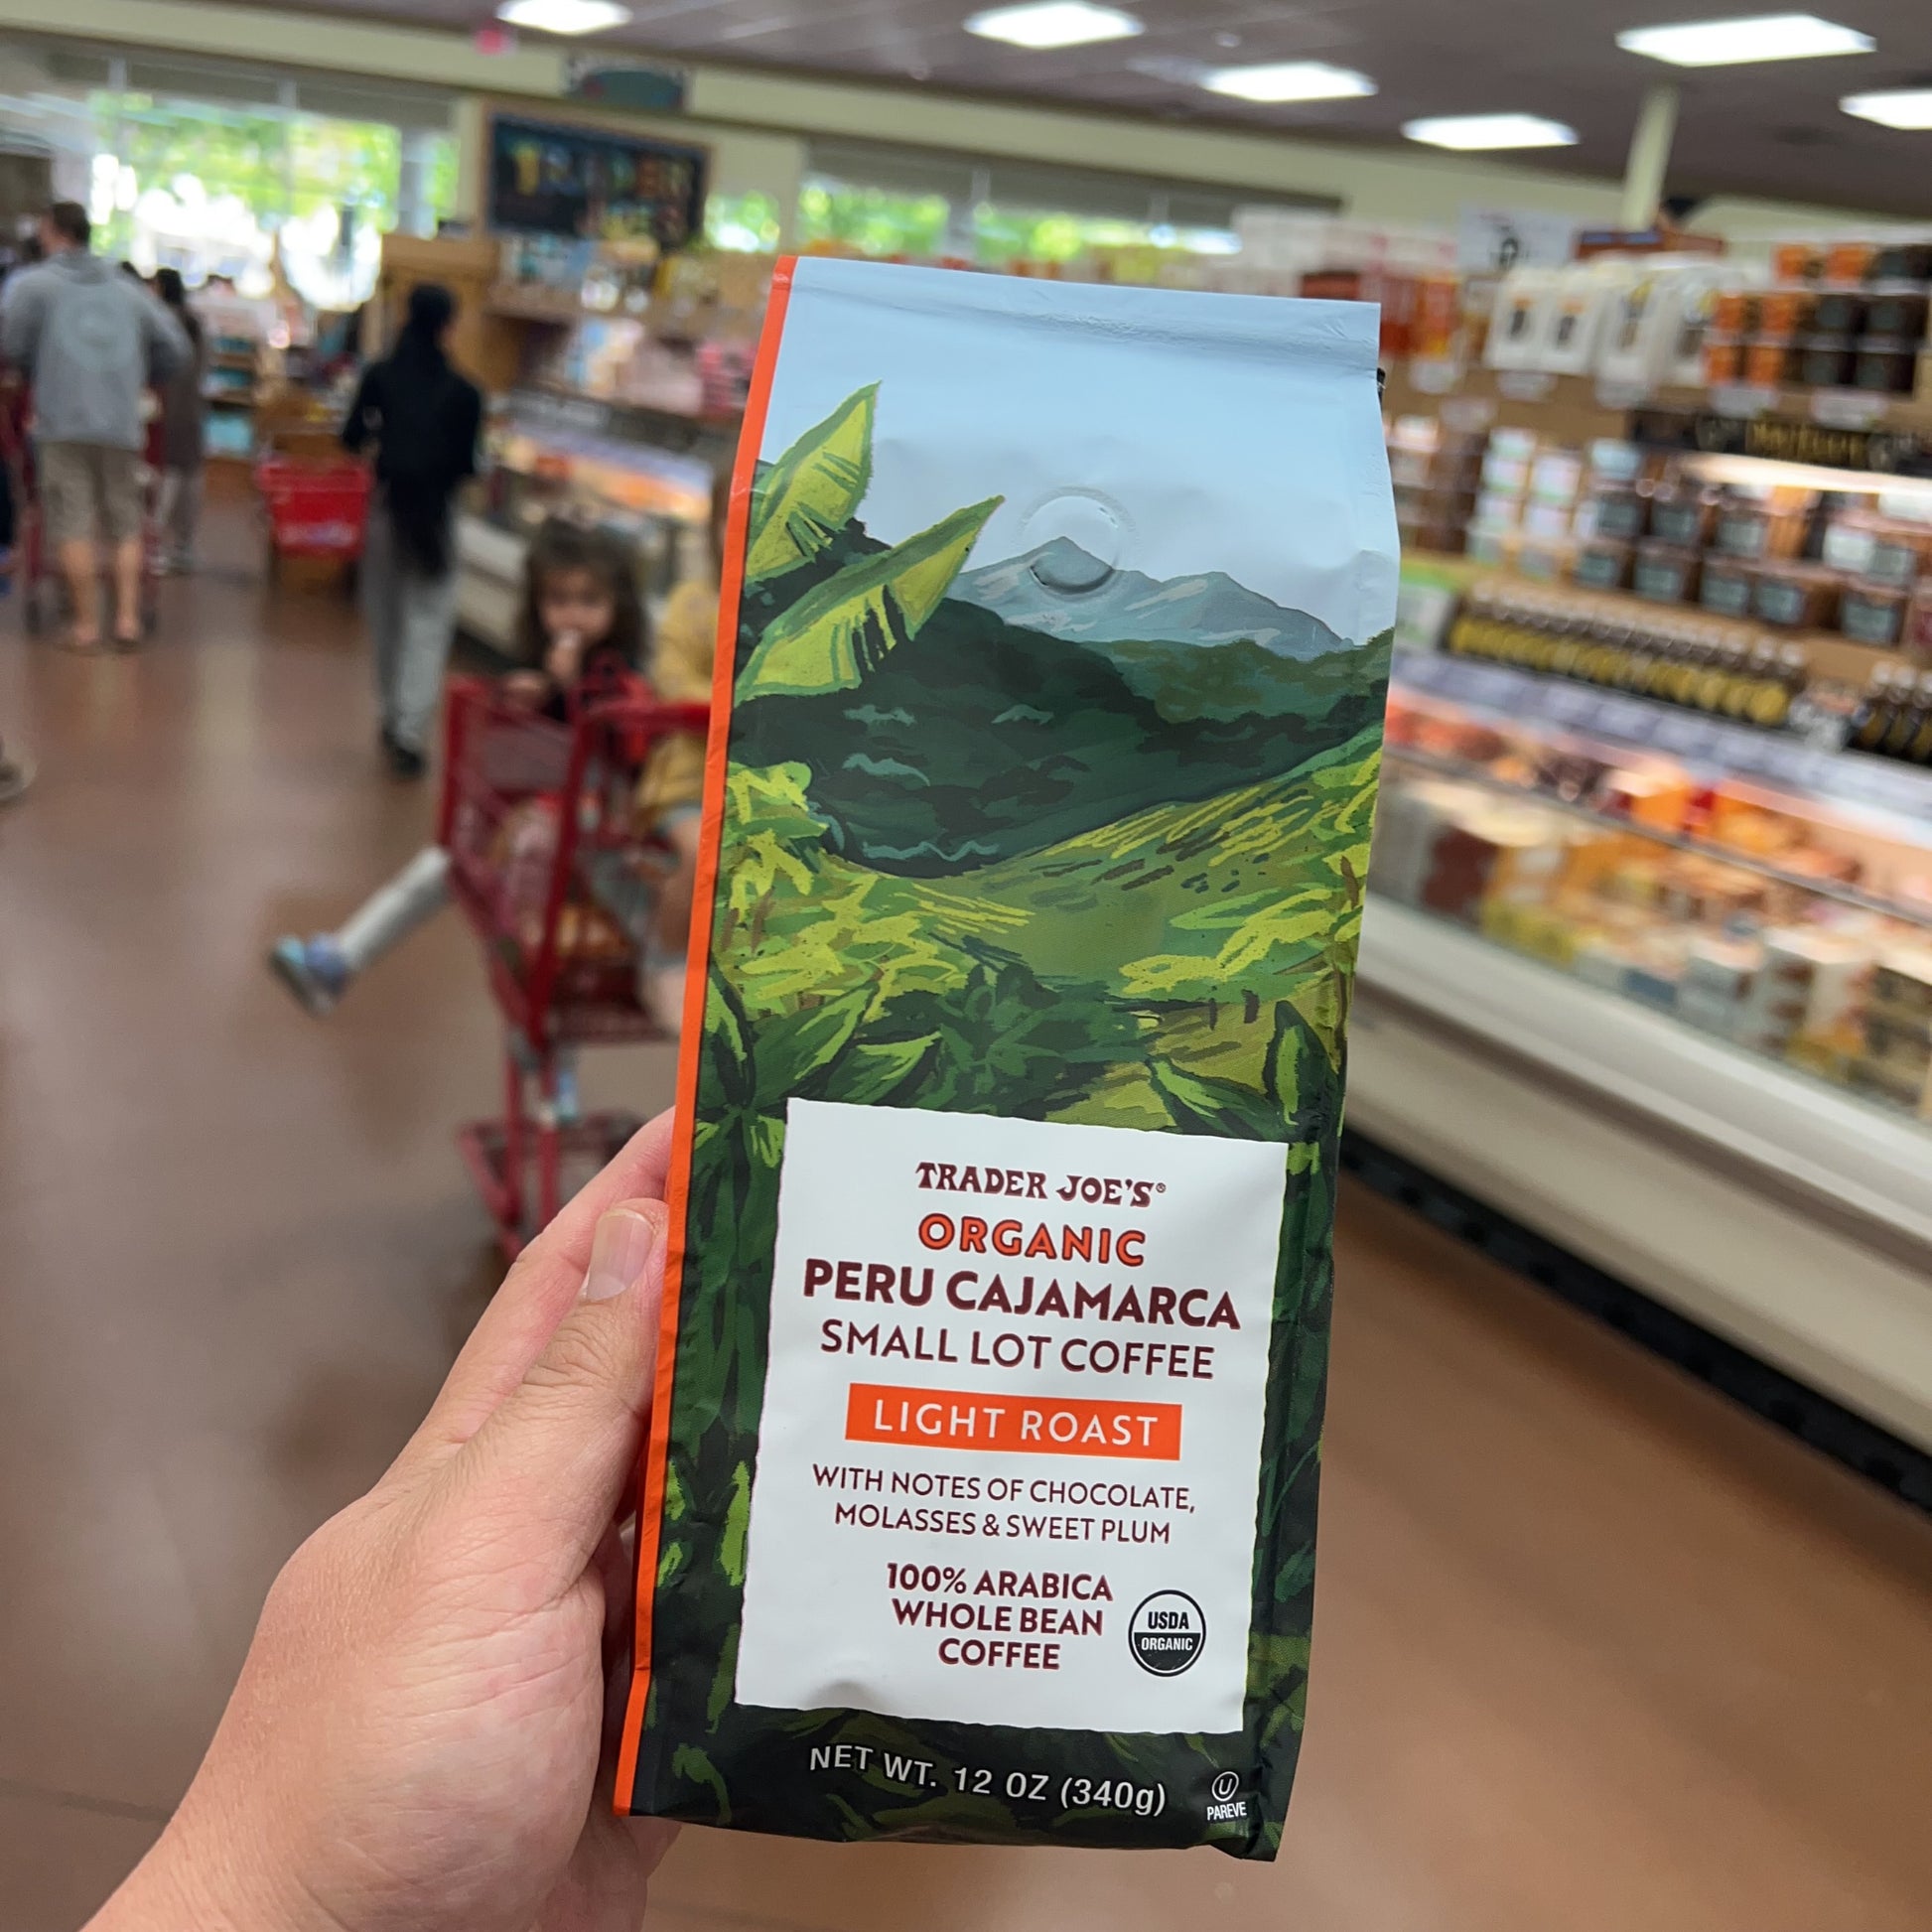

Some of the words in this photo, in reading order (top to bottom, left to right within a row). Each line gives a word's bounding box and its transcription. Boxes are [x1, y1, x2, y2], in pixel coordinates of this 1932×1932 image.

[915, 1162, 1047, 1199] TRADER
[917, 1212, 1146, 1268] ORGANIC
[803, 1258, 934, 1307] PERU
[946, 1270, 1241, 1330] CAJAMARCA
[820, 1318, 958, 1363] SMALL
[970, 1330, 1052, 1370] LOT
[1060, 1338, 1215, 1380] COFFEE
[875, 1399, 1006, 1439] LIGHT
[1021, 1410, 1159, 1447] ROAST
[812, 1463, 884, 1492] WITH
[891, 1471, 981, 1500] NOTES
[987, 1477, 1025, 1502] OF
[1030, 1479, 1195, 1514] CHOCOLATE,
[835, 1502, 976, 1536] MOLASSES
[982, 1513, 1000, 1537] &
[1006, 1514, 1096, 1541] SWEET
[1101, 1519, 1170, 1545] PLUM
[887, 1562, 967, 1594] 100%
[972, 1570, 1113, 1601] ARABICA
[892, 1597, 1013, 1632] WHOLE
[1019, 1606, 1103, 1636] BEAN
[1148, 1610, 1190, 1630] USDA
[938, 1637, 1060, 1670] COFFEE
[1141, 1636, 1193, 1651] ORGANIC
[810, 1744, 874, 1771] NET
[884, 1752, 936, 1787] WT.
[954, 1767, 993, 1794] 12
[1006, 1772, 1049, 1801] OZ
[1060, 1777, 1166, 1817] (340g)
[1206, 1801, 1248, 1821] PAREVE
